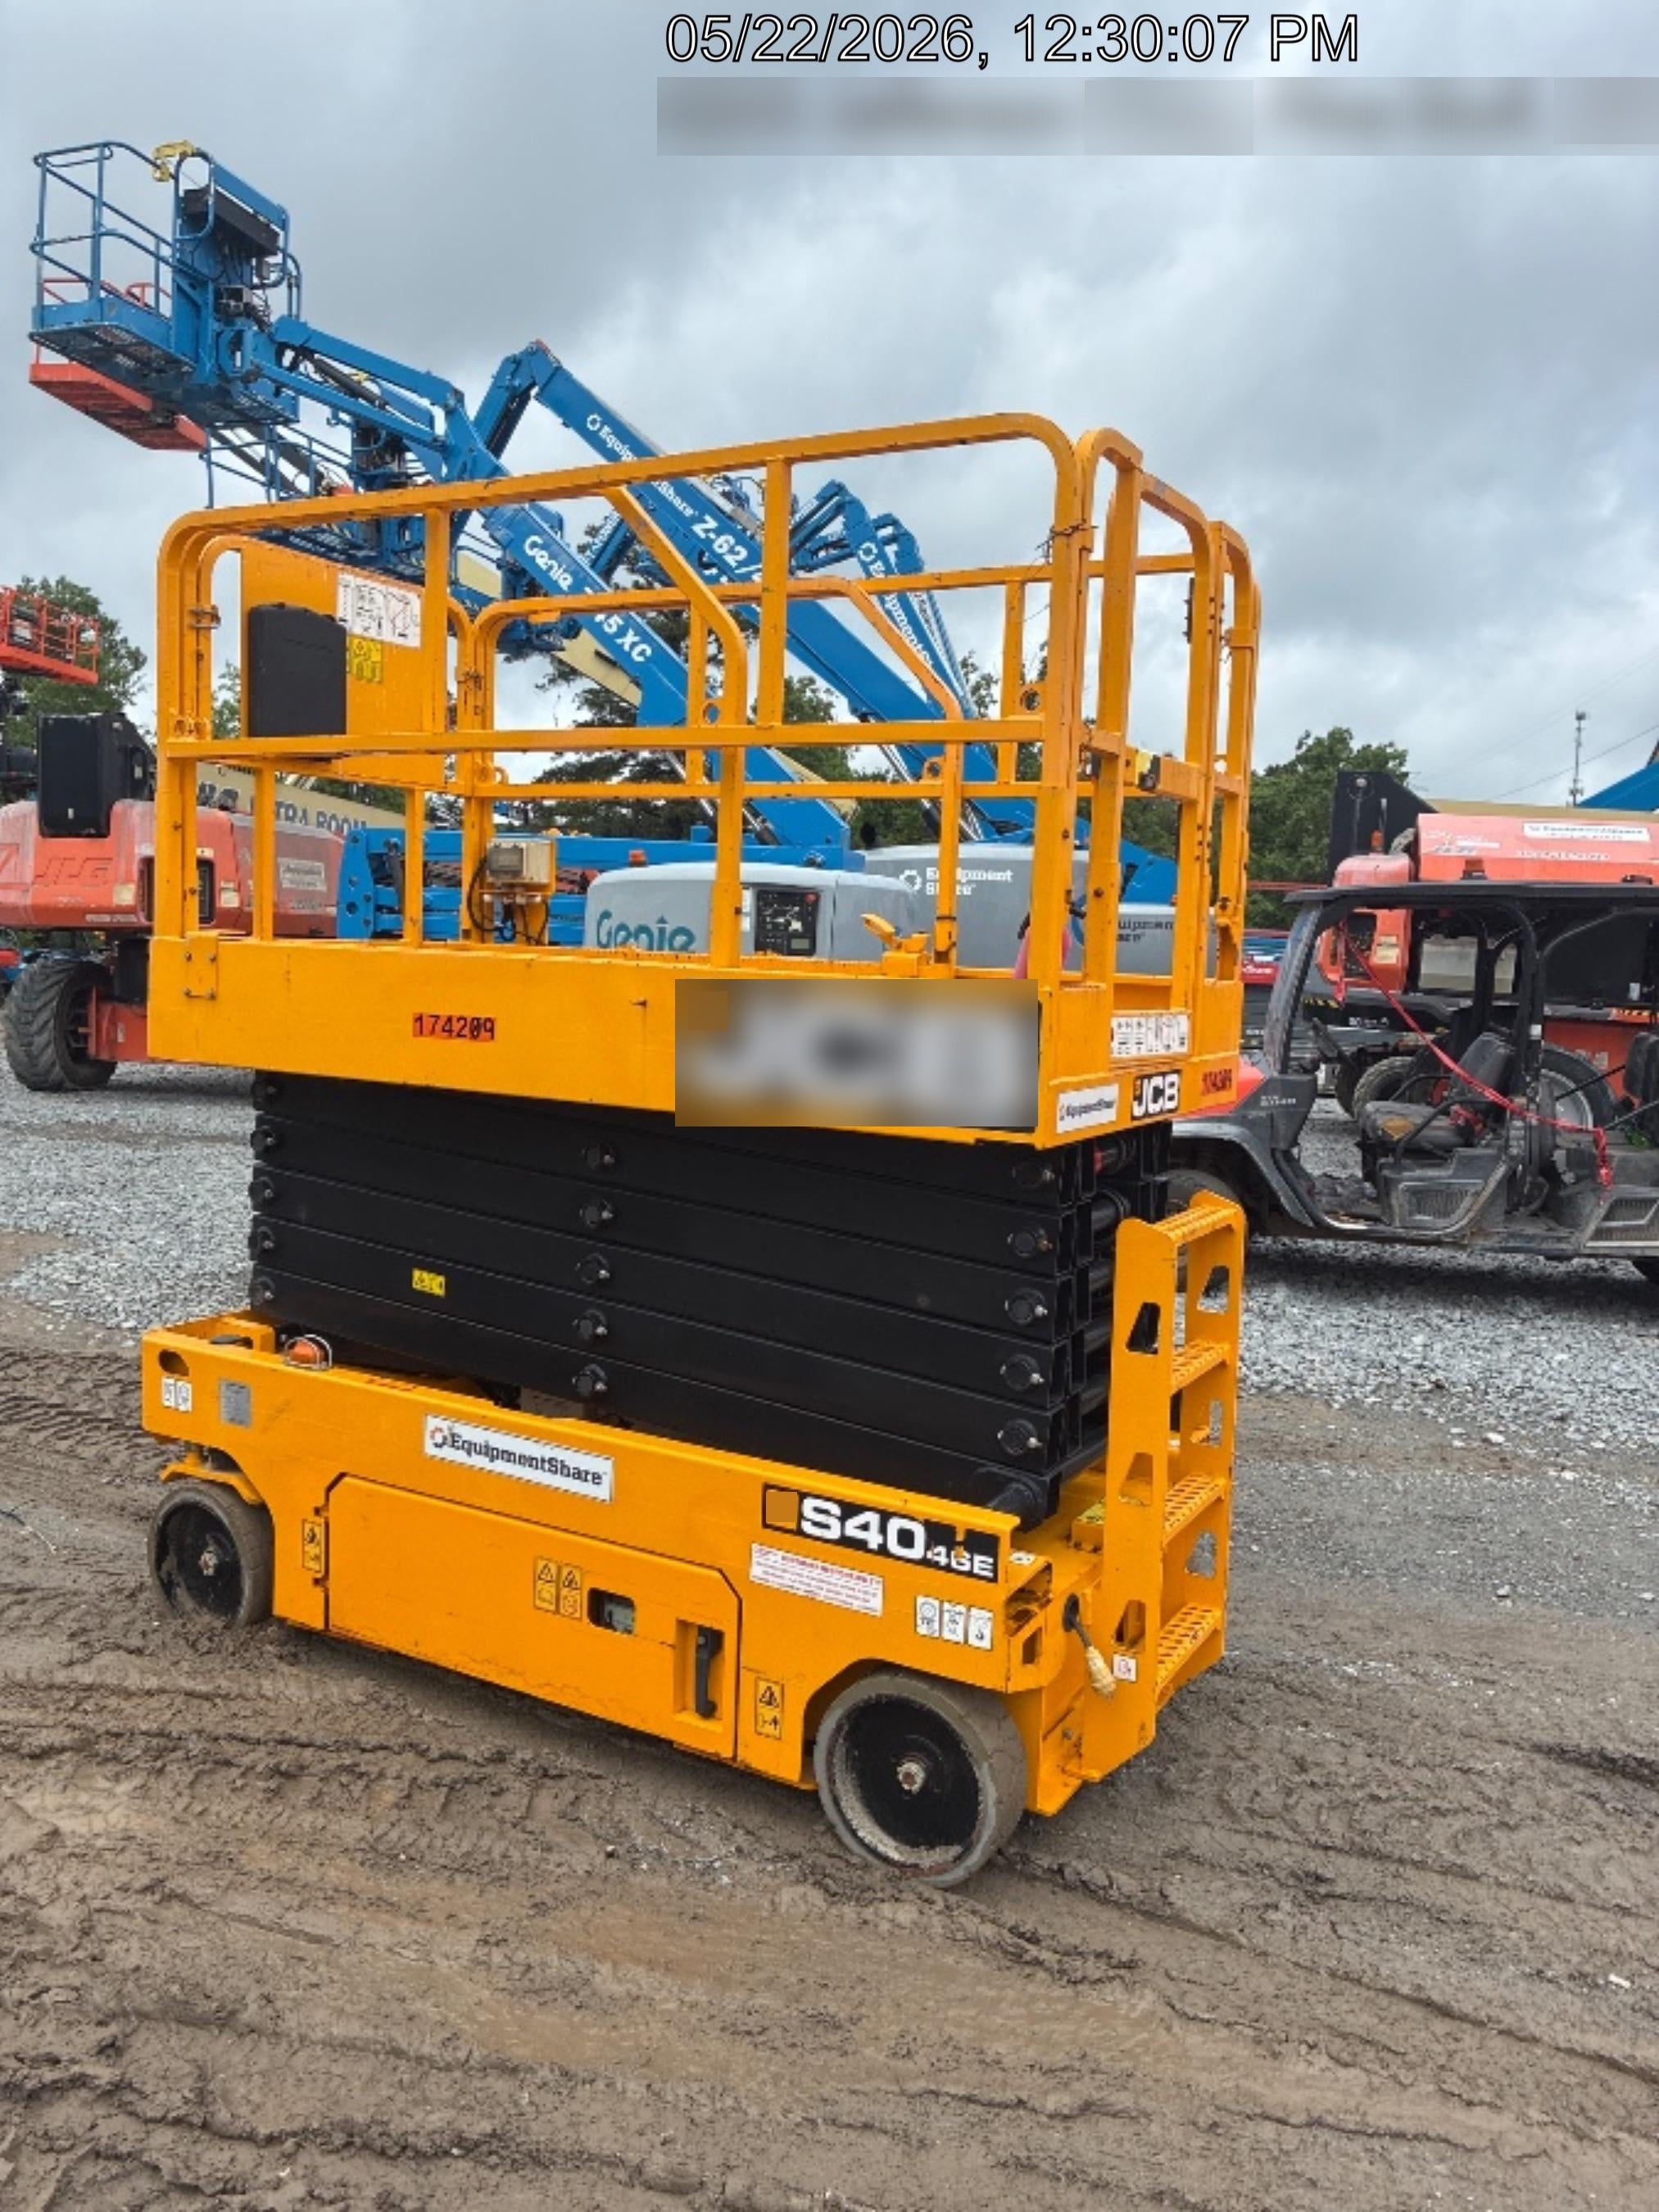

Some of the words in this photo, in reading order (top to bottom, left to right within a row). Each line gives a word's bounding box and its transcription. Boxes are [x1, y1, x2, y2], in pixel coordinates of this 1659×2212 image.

[524, 535, 573, 591] Genie
[615, 628, 652, 662] XC
[596, 909, 696, 952] Genie
[1131, 1072, 1181, 1117] JCB
[450, 1432, 603, 1486] EquipmentShare
